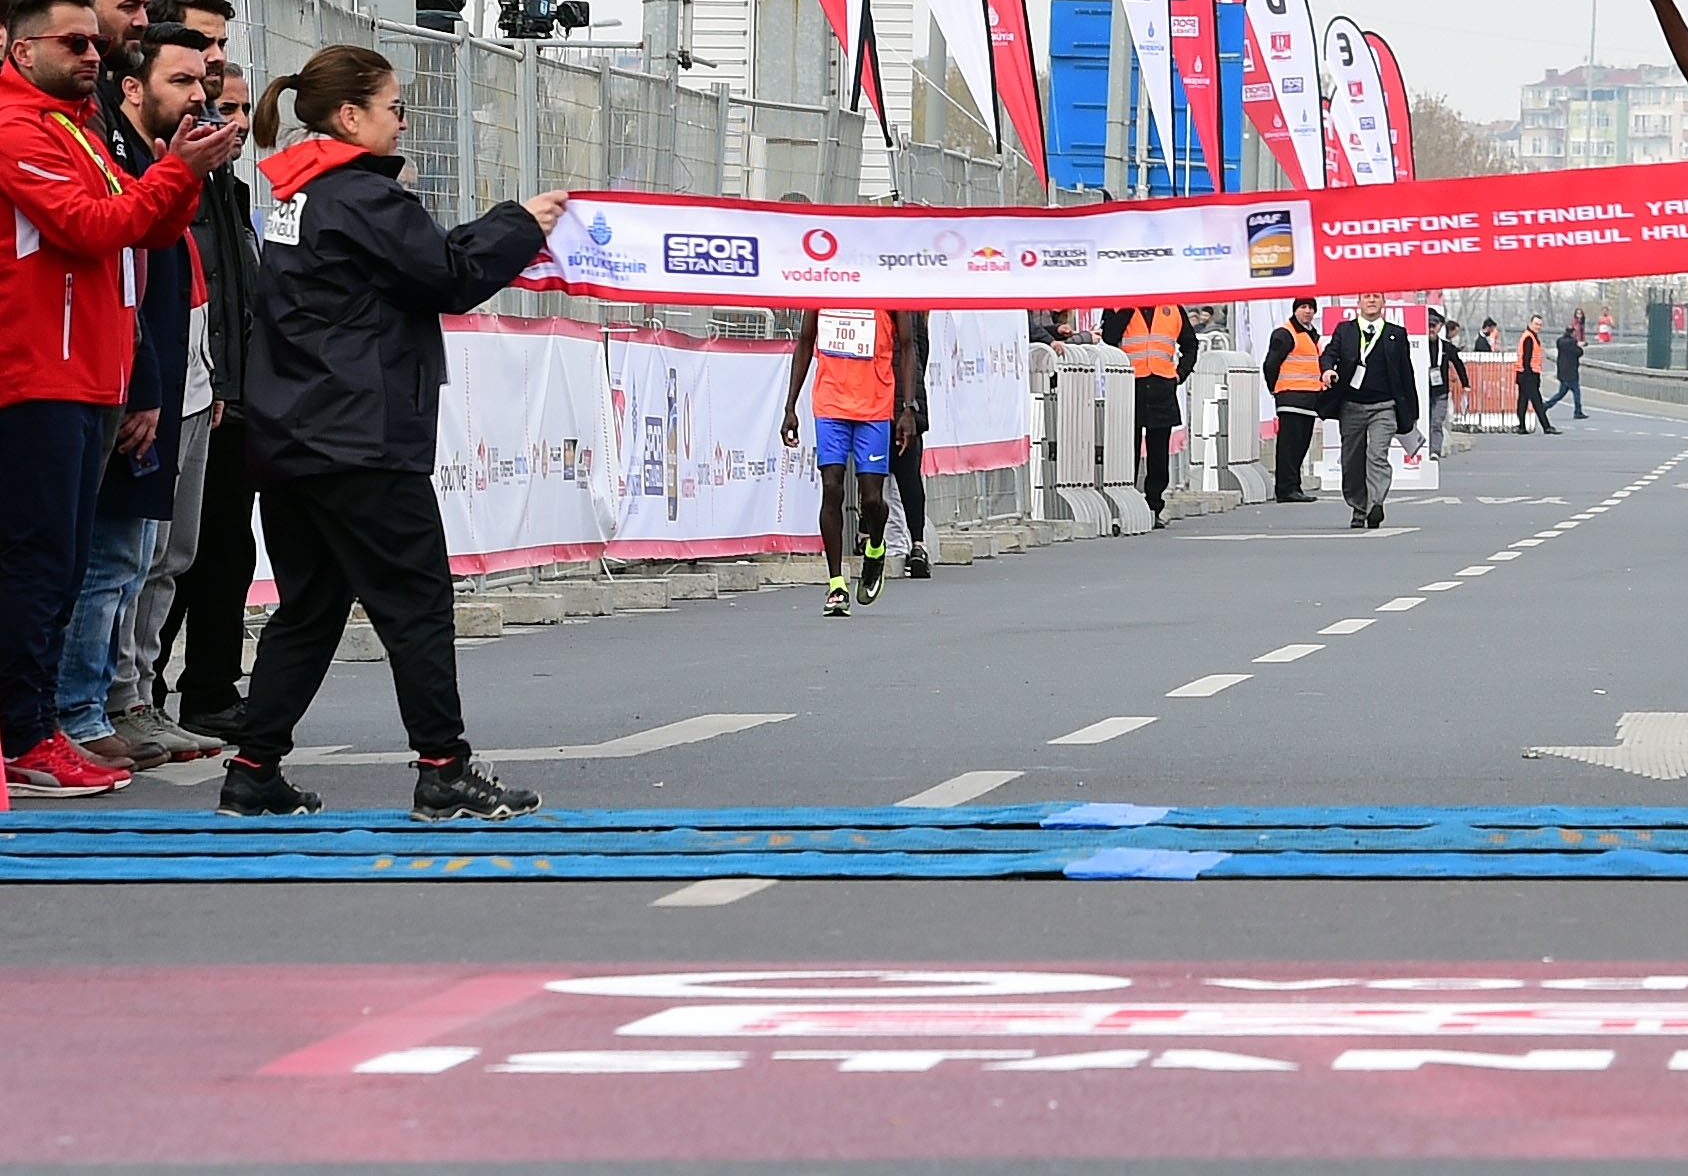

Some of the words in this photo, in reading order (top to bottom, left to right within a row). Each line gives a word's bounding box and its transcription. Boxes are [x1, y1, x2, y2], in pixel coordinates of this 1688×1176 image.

[1322, 212, 1480, 236] VODAFONE
[668, 236, 756, 260] SPOR
[1042, 248, 1088, 258] TURKISH
[1182, 244, 1232, 256] damla
[1323, 237, 1481, 260] VODAFONE
[878, 248, 949, 271] sportive
[1042, 258, 1088, 268] AIRLINES
[967, 262, 988, 271] Red
[990, 262, 1011, 272] Bull
[782, 266, 861, 283] vodafone
[836, 328, 855, 340] TOO
